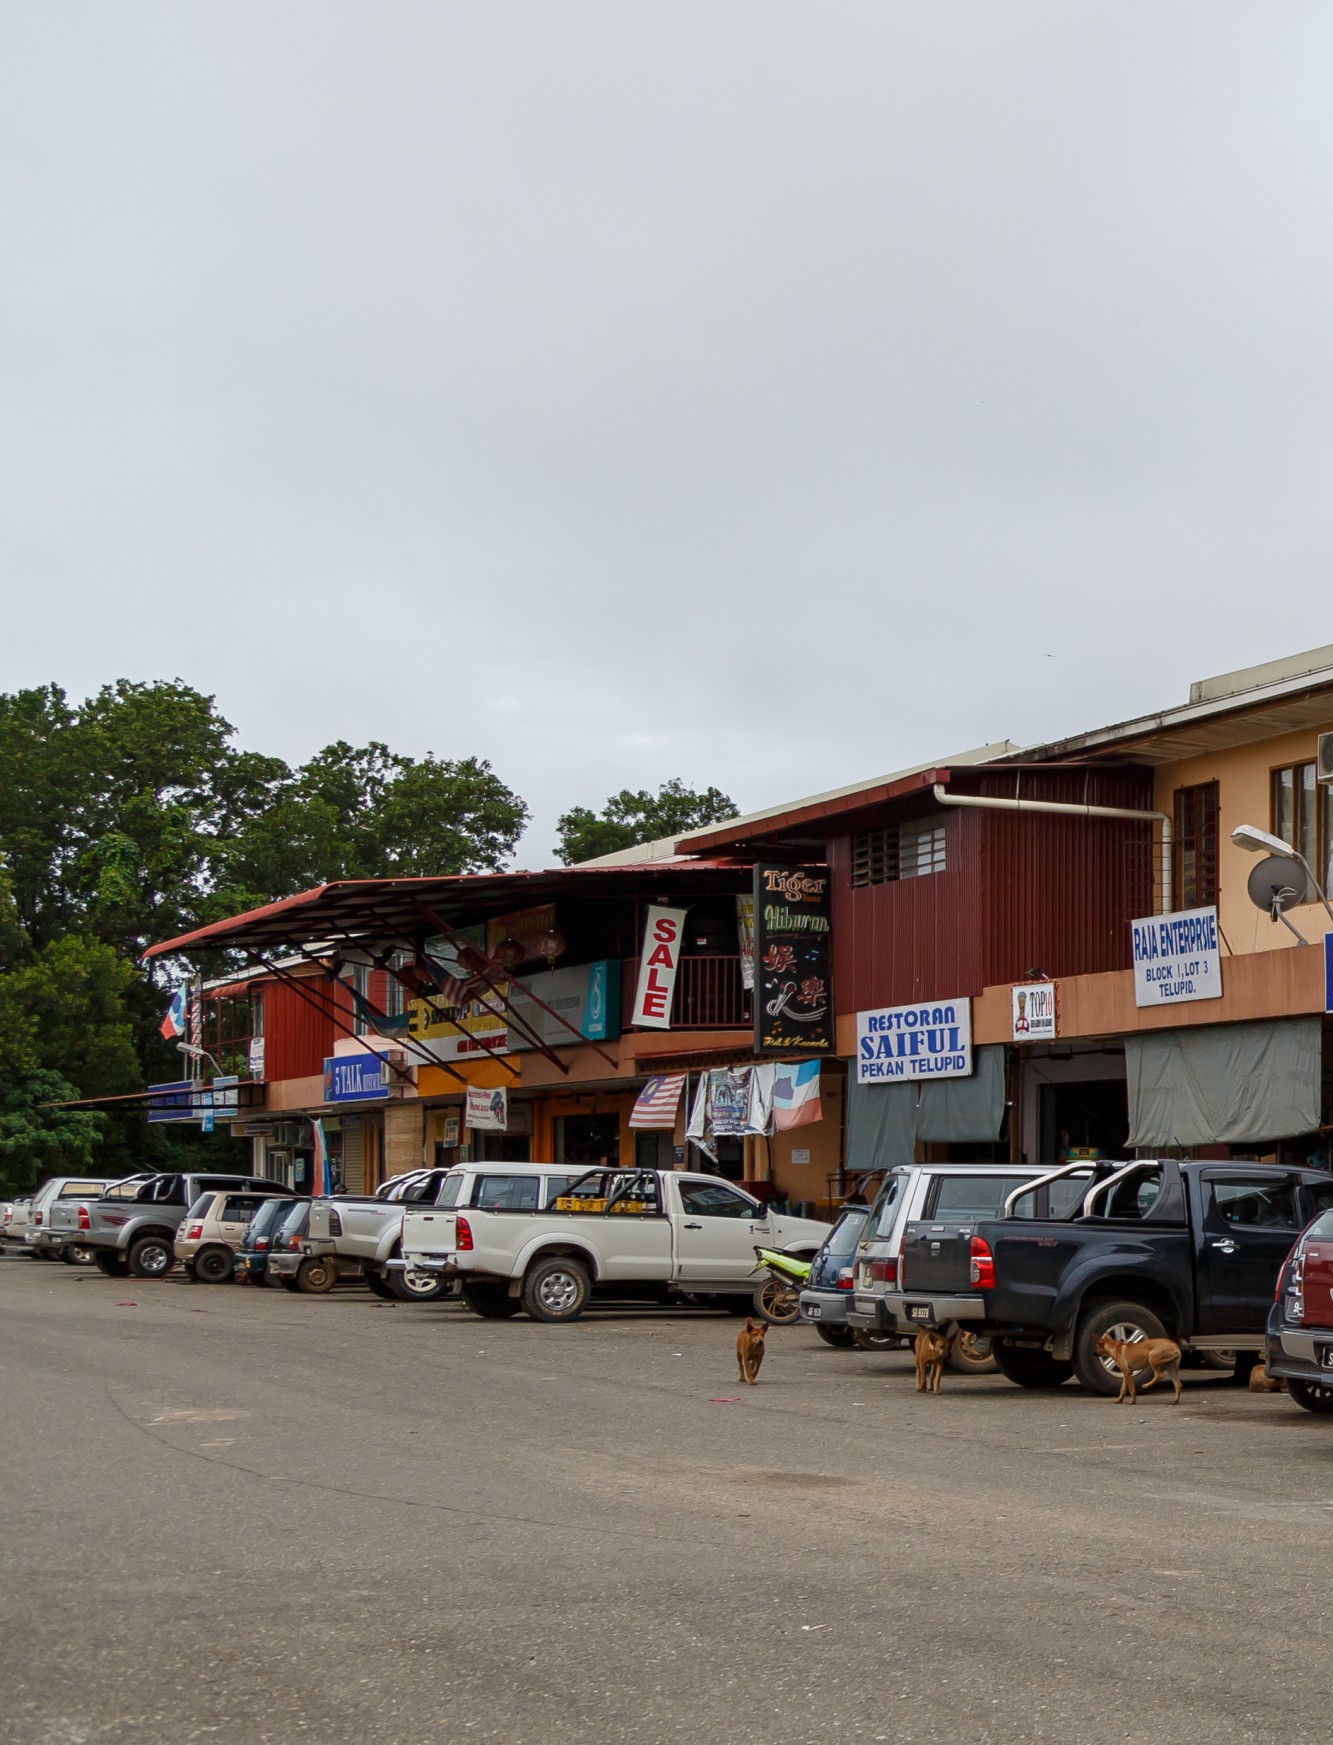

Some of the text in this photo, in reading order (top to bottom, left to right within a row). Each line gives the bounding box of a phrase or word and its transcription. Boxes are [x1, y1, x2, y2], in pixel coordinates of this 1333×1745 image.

[763, 870, 827, 901] Tiger
[764, 904, 830, 931] Hiburan
[1133, 914, 1217, 962] RAJA ENTERPRSIE
[646, 918, 677, 1018] SALE
[1146, 965, 1173, 982] BLOCK
[1203, 960, 1209, 974] 3
[1159, 980, 1196, 997] TELUPID.
[868, 1006, 956, 1033] RESTORAN
[860, 1027, 966, 1060] SAIFUL
[335, 1066, 340, 1095] 5
[340, 1063, 363, 1094] TALK
[861, 1055, 966, 1078] PEKAN TELUPID
